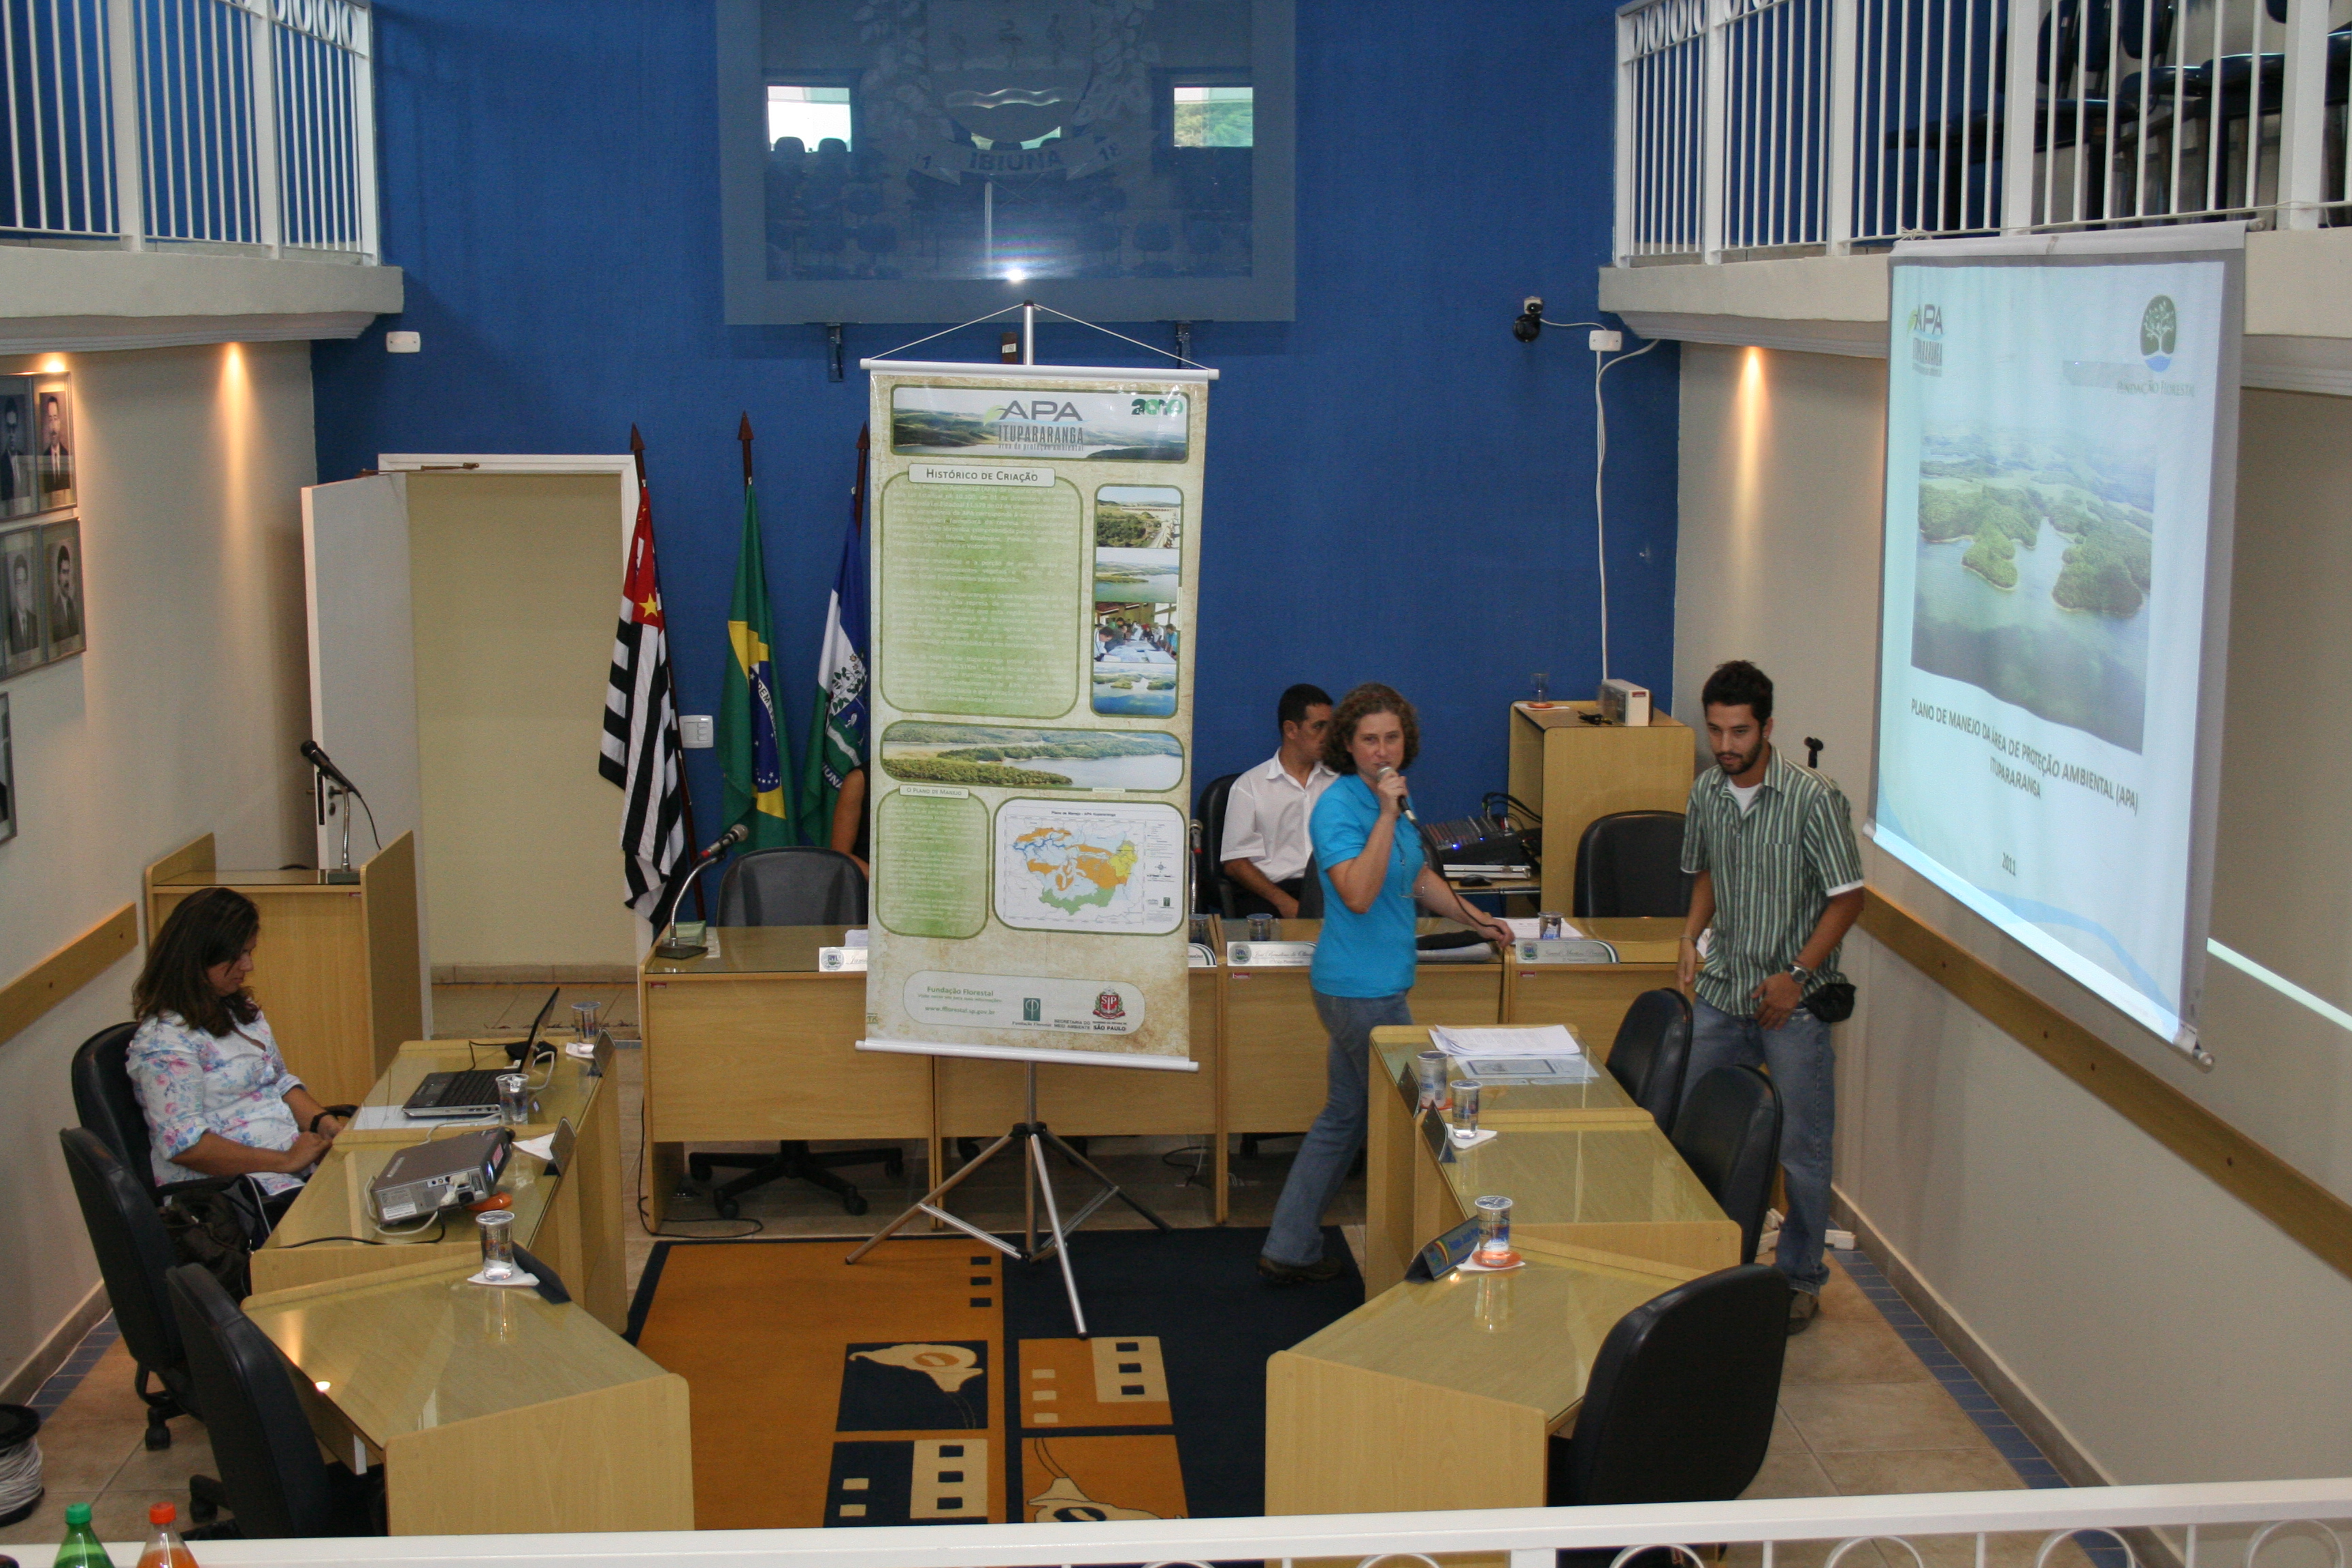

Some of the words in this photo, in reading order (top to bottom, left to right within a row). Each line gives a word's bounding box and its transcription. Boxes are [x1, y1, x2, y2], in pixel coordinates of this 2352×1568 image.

[1914, 304, 1943, 334] APA
[998, 400, 1083, 422] APA
[998, 425, 1083, 444] ITUPARARANGA
[926, 468, 978, 480] HISTÓRICO
[996, 471, 1039, 483] CRIAÇÃO
[1911, 698, 1935, 721] PLANO
[1936, 706, 1947, 725] DE
[1948, 710, 1980, 736] MANEJO
[1982, 722, 1991, 742] DA
[1991, 725, 2007, 753] ÁREA
[2008, 739, 2020, 758] DE
[2021, 744, 2060, 777] PROTEÇÃO
[2061, 762, 2114, 800] AMBIENTAL
[2116, 783, 2138, 817] (APA)
[1990, 755, 2041, 800] ITUPARARANGA
[2002, 851, 2016, 877] 2011
[927, 987, 961, 995] Fundação
